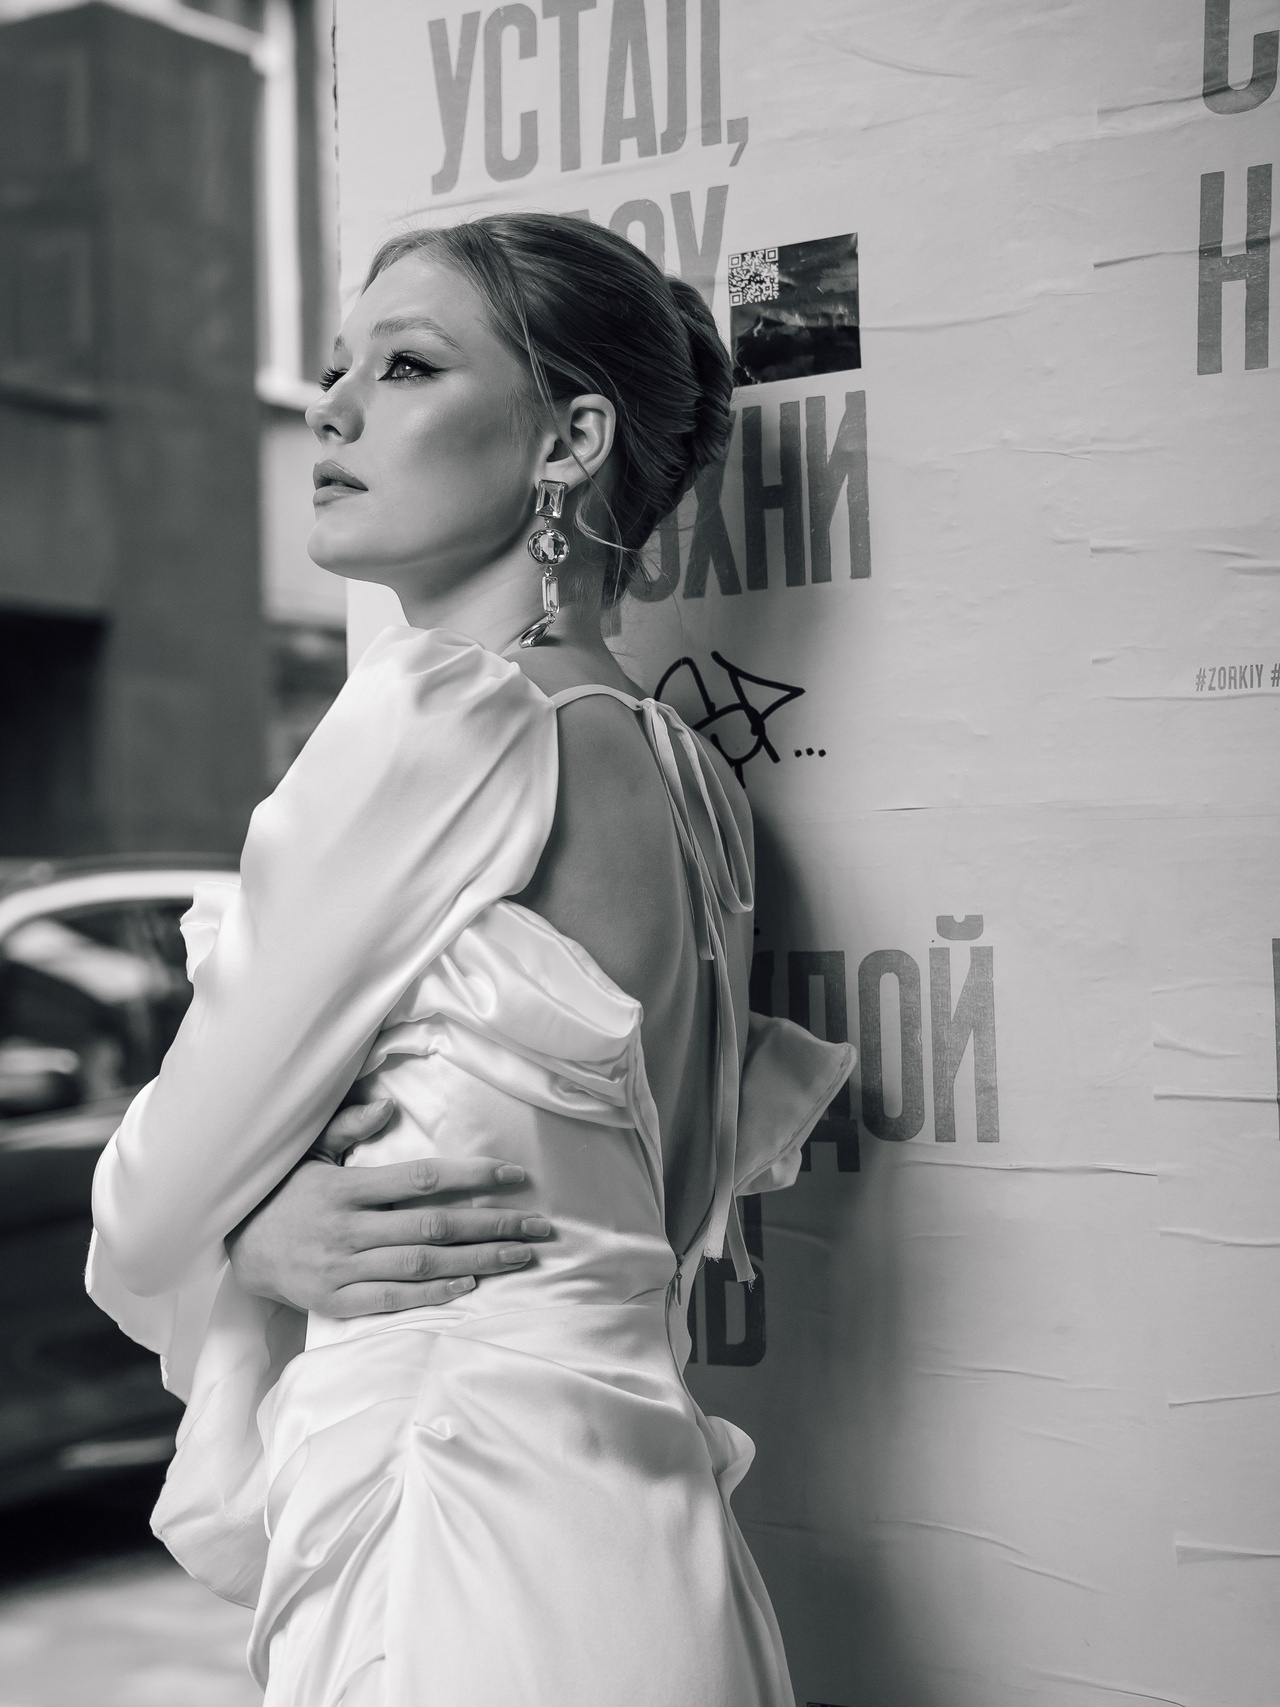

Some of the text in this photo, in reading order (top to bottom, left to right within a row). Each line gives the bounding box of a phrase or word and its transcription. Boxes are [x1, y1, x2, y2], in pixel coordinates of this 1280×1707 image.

[427, 0, 749, 195] УСТАЛ,
[1195, 664, 1264, 692] #ZORKIY
[749, 915, 1001, 1172] ДОЙ
